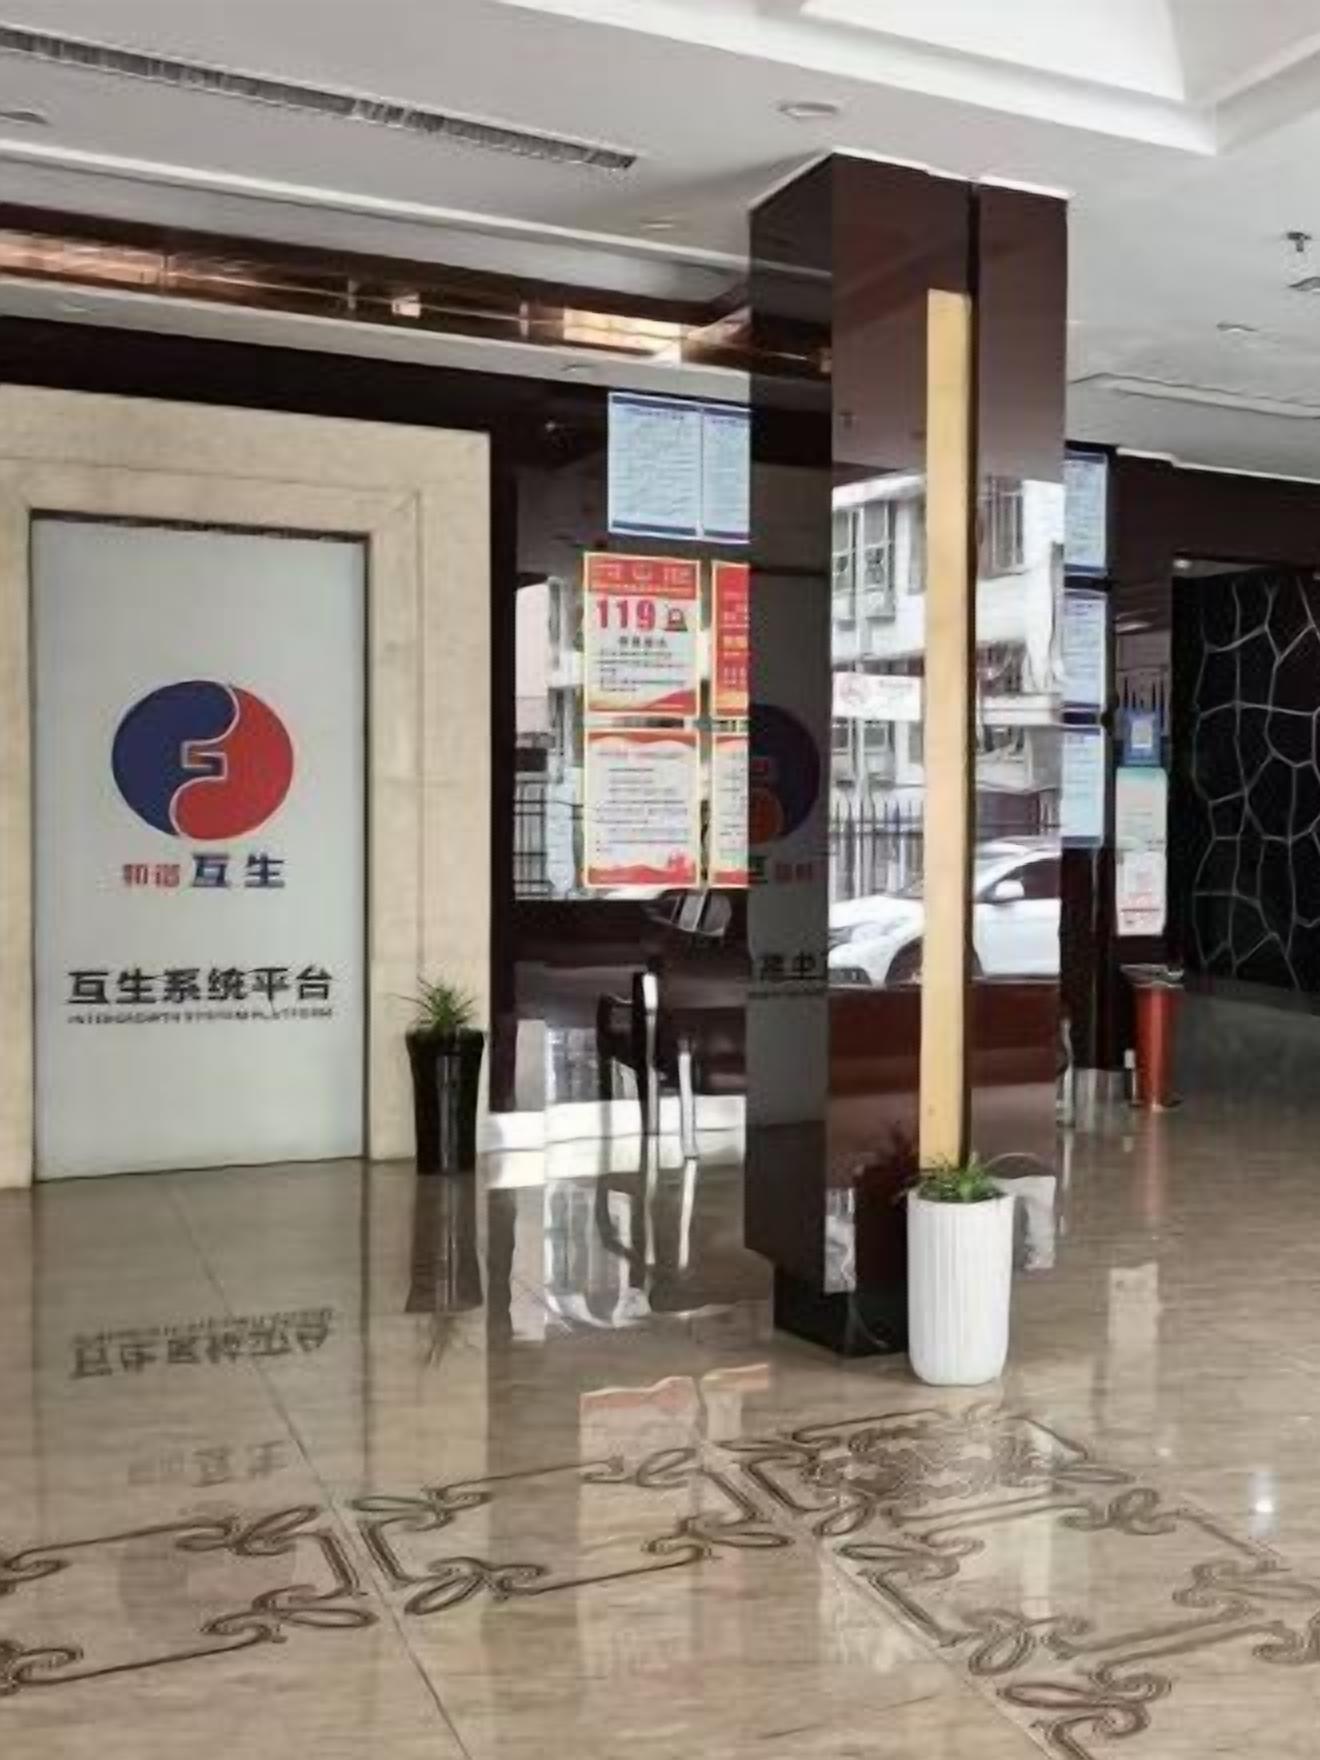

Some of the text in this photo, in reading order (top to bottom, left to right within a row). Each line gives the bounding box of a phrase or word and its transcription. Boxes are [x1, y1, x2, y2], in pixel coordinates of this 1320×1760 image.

[597, 600, 656, 632] 119
[67, 966, 333, 1004] 互生系统平台
